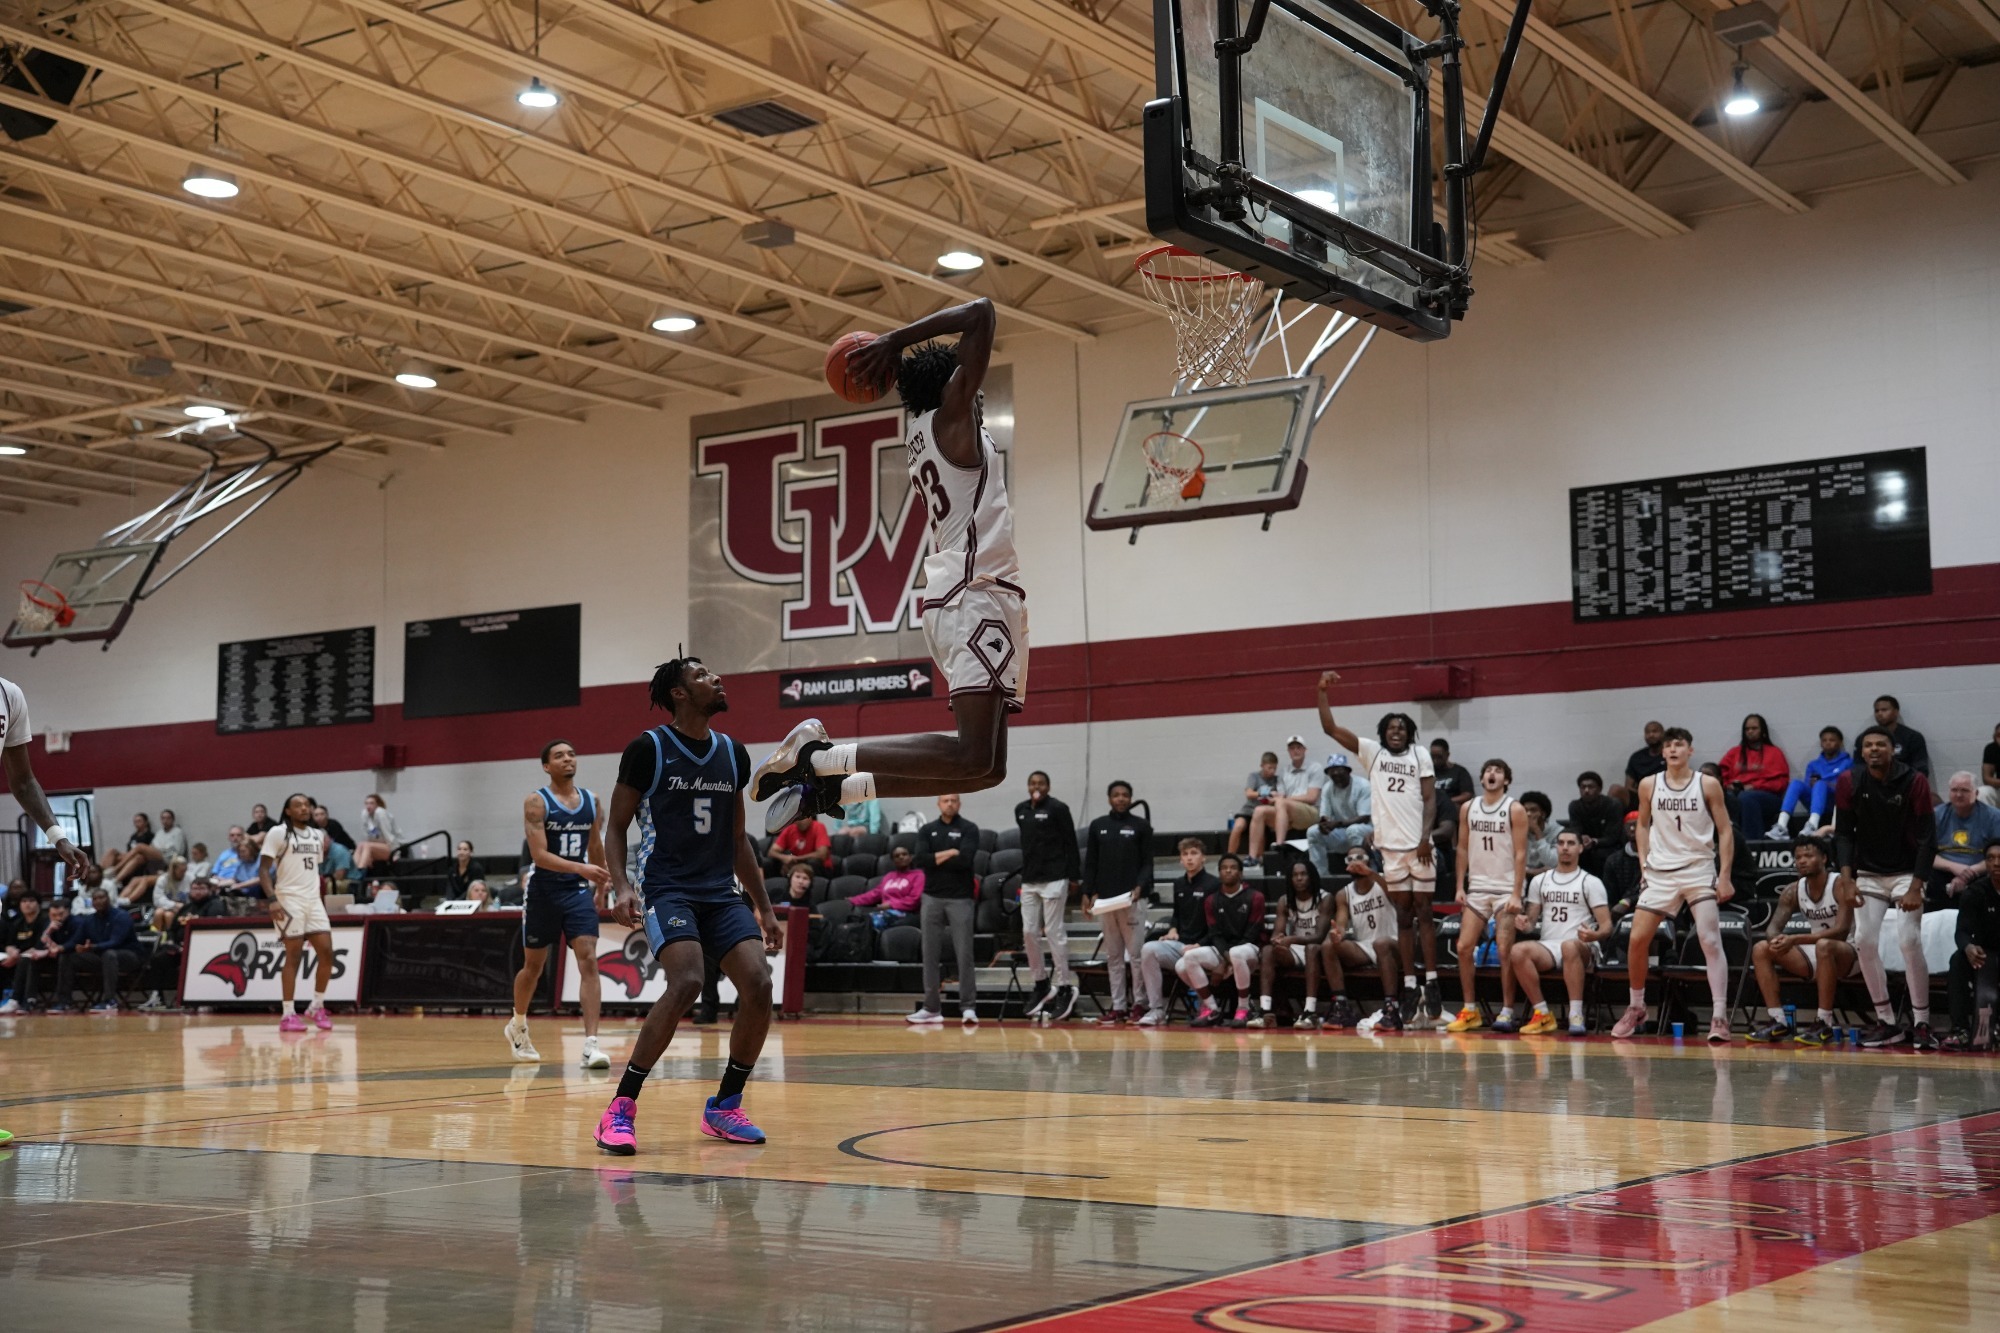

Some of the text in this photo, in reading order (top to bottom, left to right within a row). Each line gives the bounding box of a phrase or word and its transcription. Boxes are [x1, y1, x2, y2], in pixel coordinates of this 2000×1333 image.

[803, 674, 908, 696] RAM CLUB MEMBERS
[1379, 760, 1416, 778] MOBILE
[667, 775, 734, 793] The Mountain
[1387, 777, 1406, 793] 22
[1657, 798, 1699, 812] MOBILE
[693, 797, 712, 835] 5
[1674, 815, 1682, 832] 1
[545, 820, 562, 831] The
[1470, 819, 1506, 834] MOBILE
[559, 833, 582, 857] 12
[1481, 835, 1495, 852] 11
[302, 857, 314, 870] 15
[1541, 891, 1580, 905] MOBILE
[1367, 914, 1377, 929] 8
[1551, 906, 1569, 922] 25
